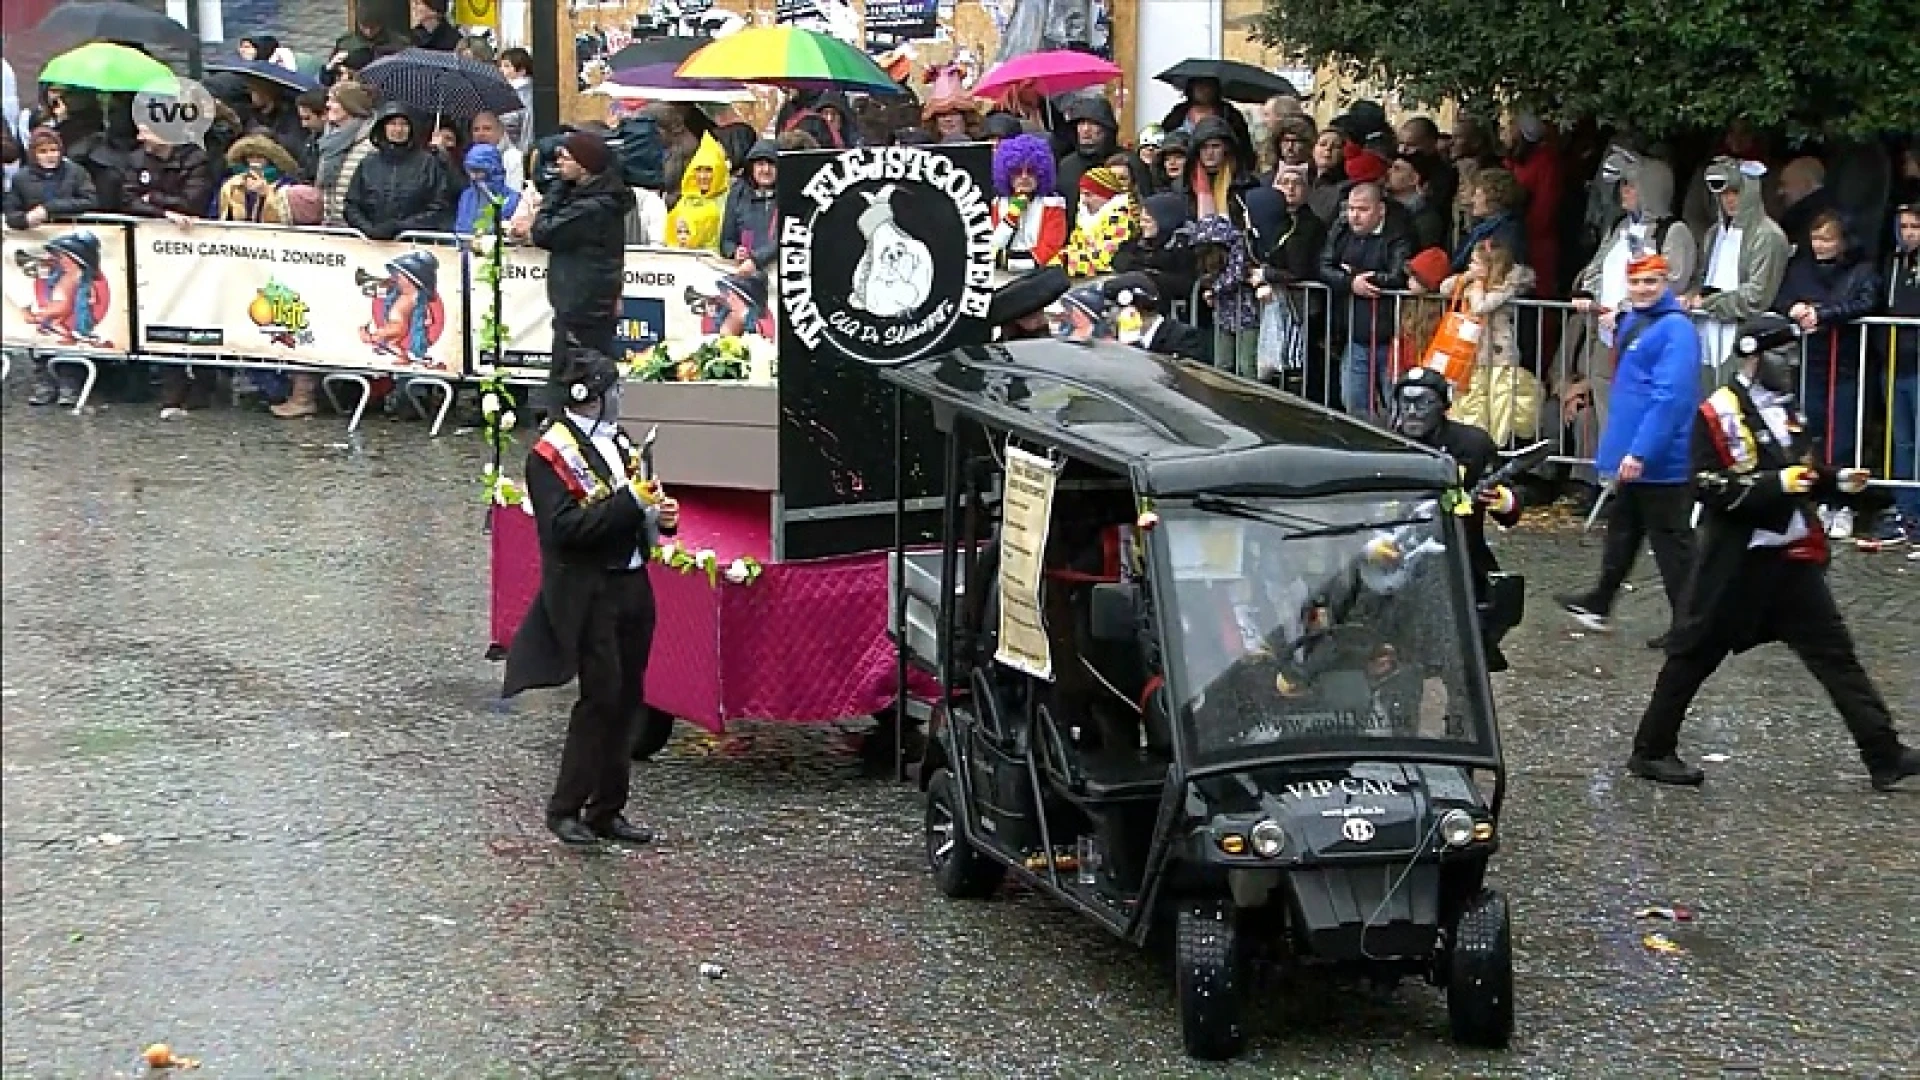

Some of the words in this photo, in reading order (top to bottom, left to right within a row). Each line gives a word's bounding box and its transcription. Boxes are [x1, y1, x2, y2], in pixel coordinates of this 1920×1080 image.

[153, 240, 192, 254] GEEN
[197, 242, 276, 261] CARNAVAL
[282, 249, 346, 267] ZONDER
[624, 271, 675, 286] ONDER
[1285, 780, 1332, 799] VIP
[1339, 777, 1398, 795] CAR
